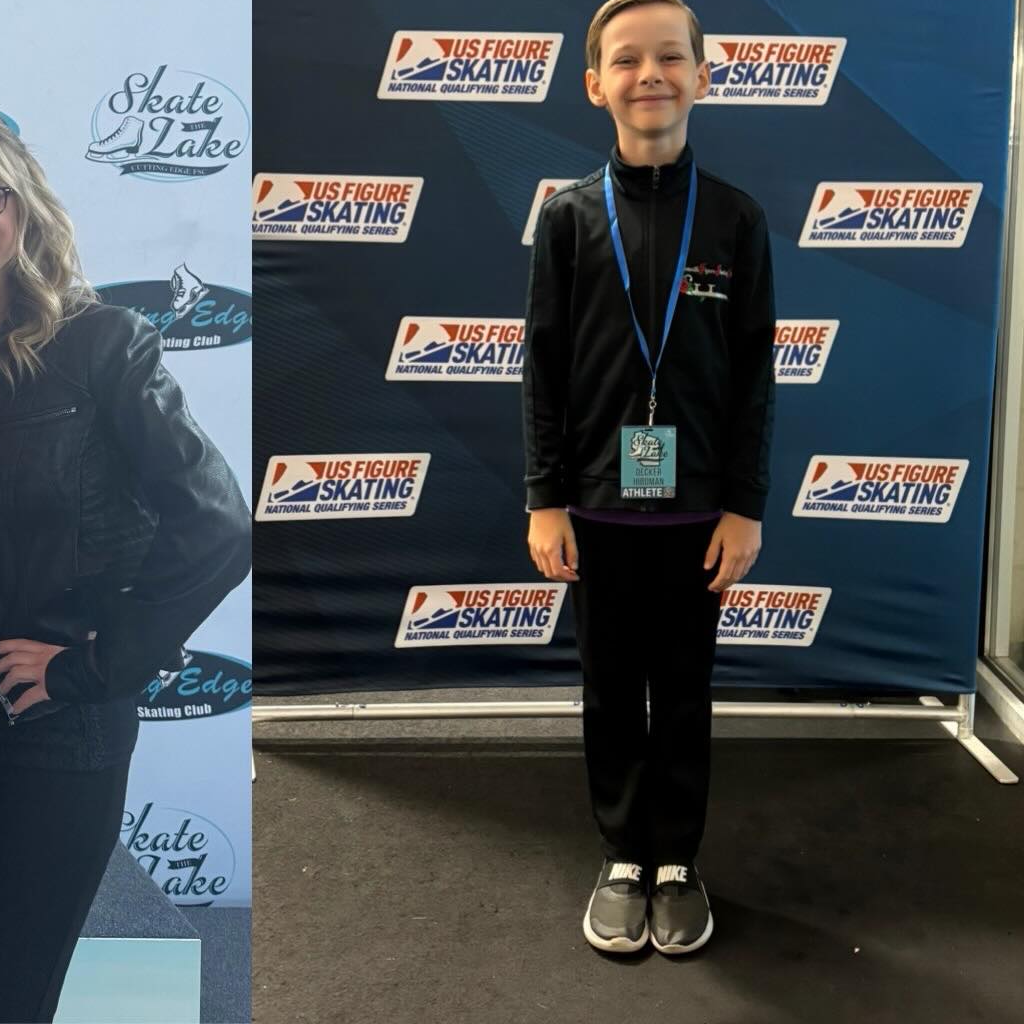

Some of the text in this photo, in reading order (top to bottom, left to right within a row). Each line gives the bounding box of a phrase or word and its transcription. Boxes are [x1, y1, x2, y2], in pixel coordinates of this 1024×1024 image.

[453, 39, 553, 59] US FIGURE
[737, 43, 837, 64] US FIGURE
[447, 59, 546, 82] SKATING
[729, 62, 828, 86] SKATING
[108, 64, 223, 114] Skate
[388, 83, 537, 94] NATIONAL QUALIFYING SERIES
[722, 88, 781, 97] QUALIFYING
[783, 89, 819, 98] SERIES
[144, 116, 241, 158] Lake
[313, 182, 413, 202] US FIGURE
[875, 190, 973, 207] US FIGURE
[307, 201, 406, 224] SKATING
[866, 208, 965, 229] SKATING
[301, 225, 359, 234] QUALIFYING
[362, 226, 398, 235] SERIES
[809, 231, 956, 240] NATIONAL QUALIFYING SERIES
[191, 300, 252, 333] Edg
[193, 335, 221, 346] Club
[458, 325, 485, 342] US
[776, 327, 829, 344] GURE
[396, 366, 442, 374] NATIONAL
[777, 368, 813, 376] SERIES
[325, 460, 421, 479] US FIGURE
[865, 464, 959, 483] US FIGURE
[320, 478, 414, 500] SKATING
[622, 487, 663, 497] ATHLETE
[857, 481, 951, 504] SKATING
[265, 501, 407, 514] NATIONAL QUALIFYING SERIES
[803, 502, 943, 515] NATIONAL QUALIFYING SERIES
[465, 590, 558, 607] US FIGURE
[728, 591, 821, 610] US FIGURE
[459, 607, 551, 627] SKATING
[721, 607, 814, 629] SKATING
[405, 629, 544, 640] NATIONAL QUALIFYING SERIES
[772, 630, 806, 639] SERIES
[137, 703, 212, 718] Skating Club
